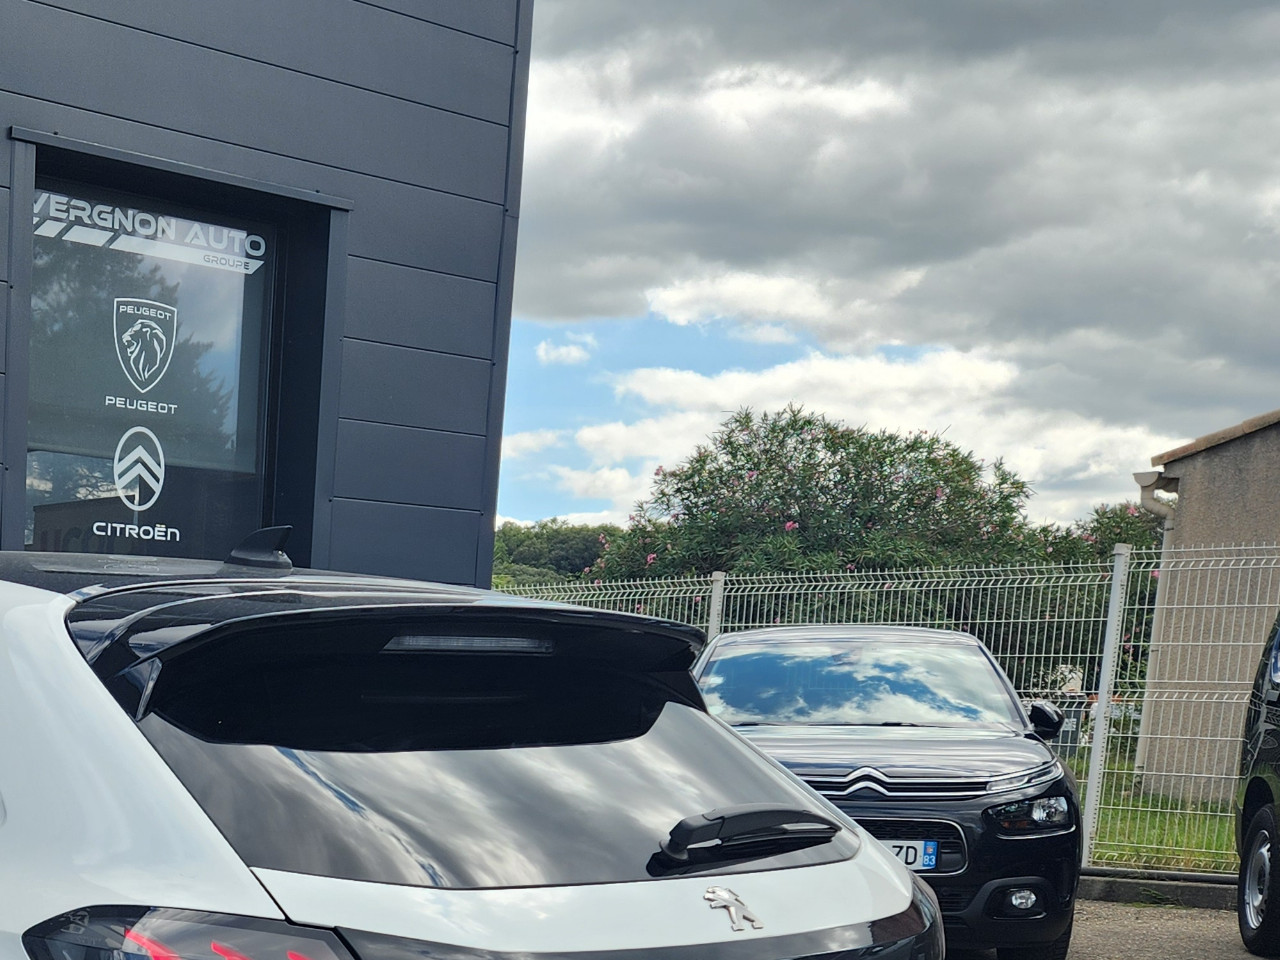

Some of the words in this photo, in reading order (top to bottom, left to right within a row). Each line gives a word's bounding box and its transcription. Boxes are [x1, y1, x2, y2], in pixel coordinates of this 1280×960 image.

[34, 192, 176, 240] VERGNON
[185, 223, 267, 258] AUTO
[203, 254, 251, 271] GROUPE
[119, 305, 173, 321] PEUGEOT
[105, 395, 179, 415] PEUGEOT
[923, 855, 937, 866] 83
